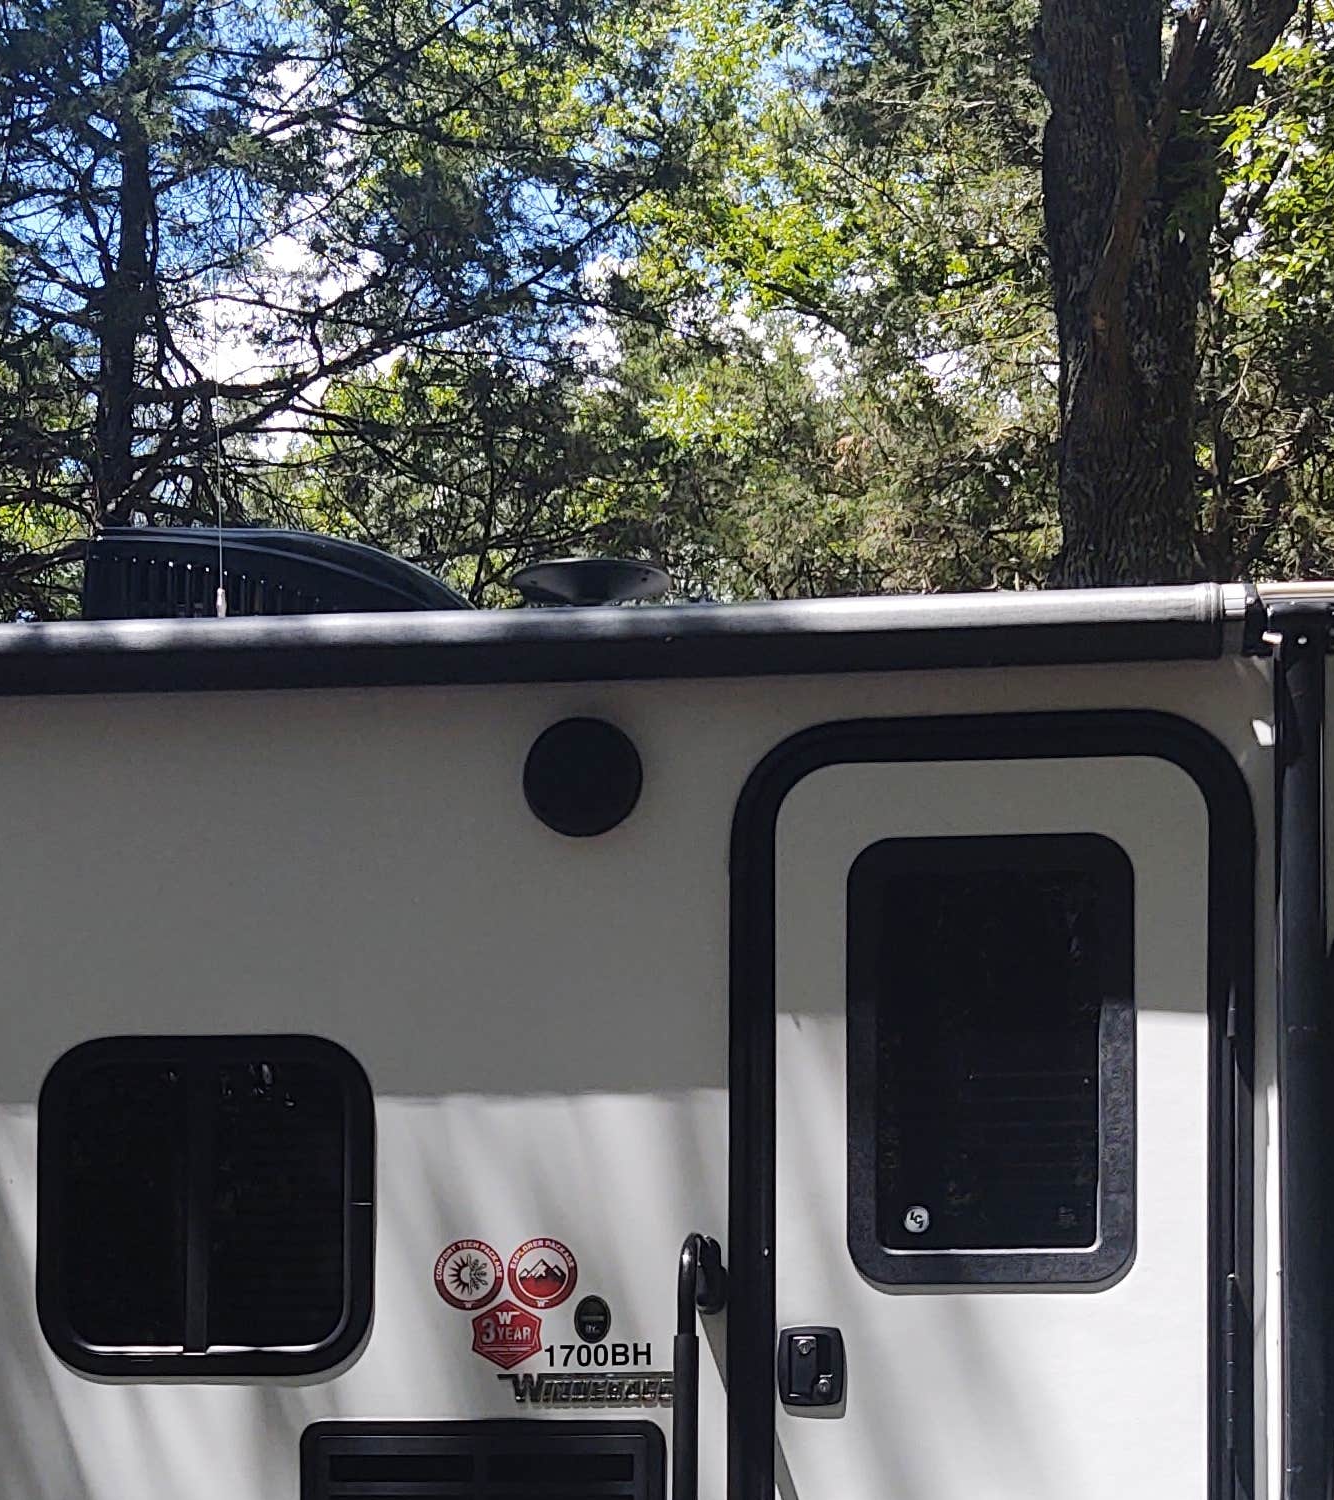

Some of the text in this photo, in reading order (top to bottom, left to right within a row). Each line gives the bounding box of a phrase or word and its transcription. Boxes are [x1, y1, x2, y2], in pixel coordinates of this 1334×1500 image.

[435, 1241, 503, 1280] COMFORT TECH PACKAGE
[509, 1239, 575, 1270] EXPLORER PACKAGE
[481, 1318, 532, 1343] 3 YEAR
[544, 1343, 652, 1367] 1700BH
